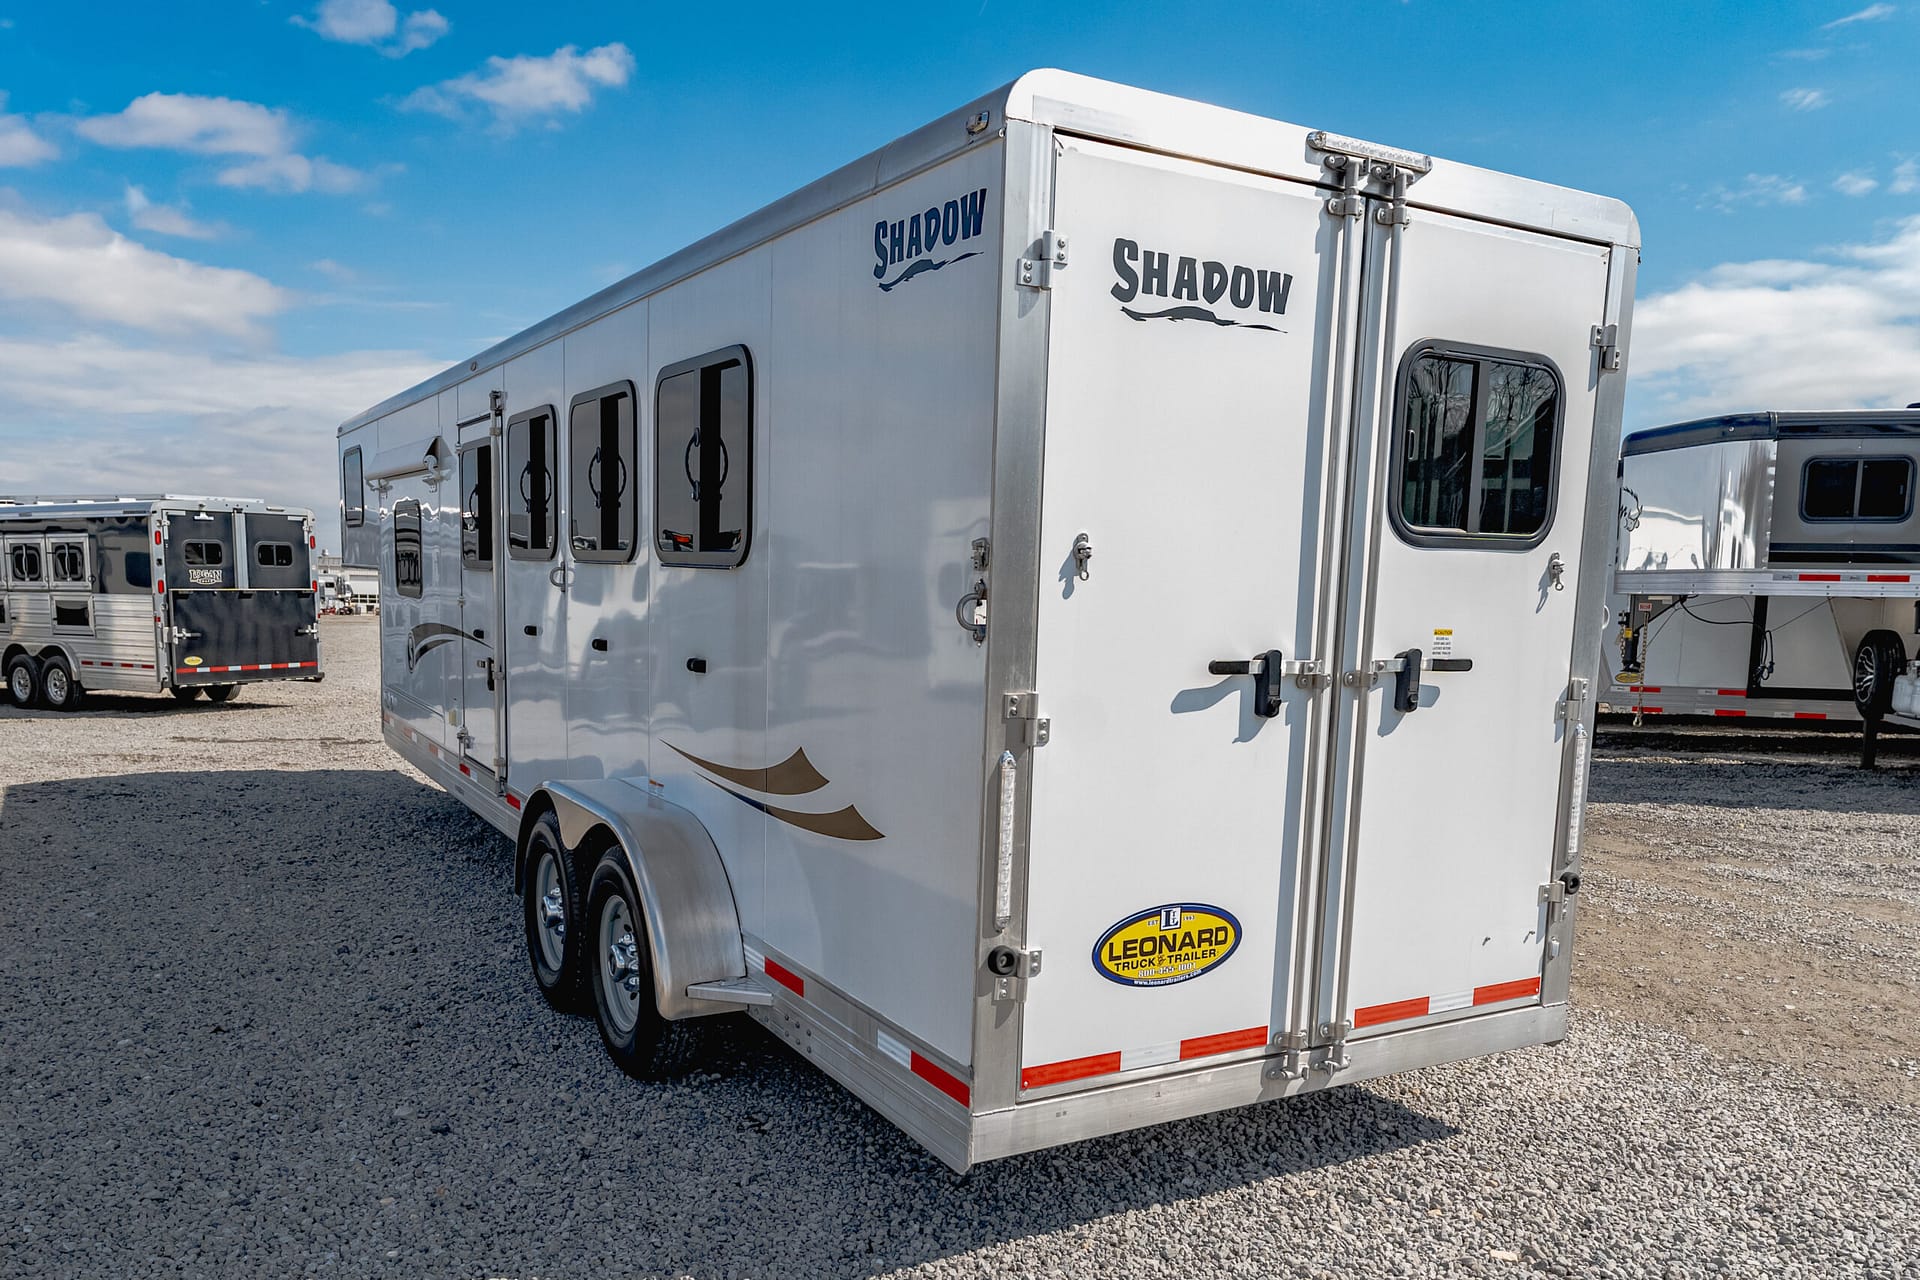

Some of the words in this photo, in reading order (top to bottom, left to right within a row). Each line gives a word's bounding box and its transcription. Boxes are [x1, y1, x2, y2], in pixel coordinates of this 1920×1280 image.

[873, 188, 987, 279] SHADOW
[1110, 237, 1293, 315] SHADOW
[189, 569, 222, 583] LOGAN
[1108, 926, 1229, 962] LEONARD
[1114, 956, 1156, 972] TRUCK
[1167, 948, 1217, 965] TRAILER
